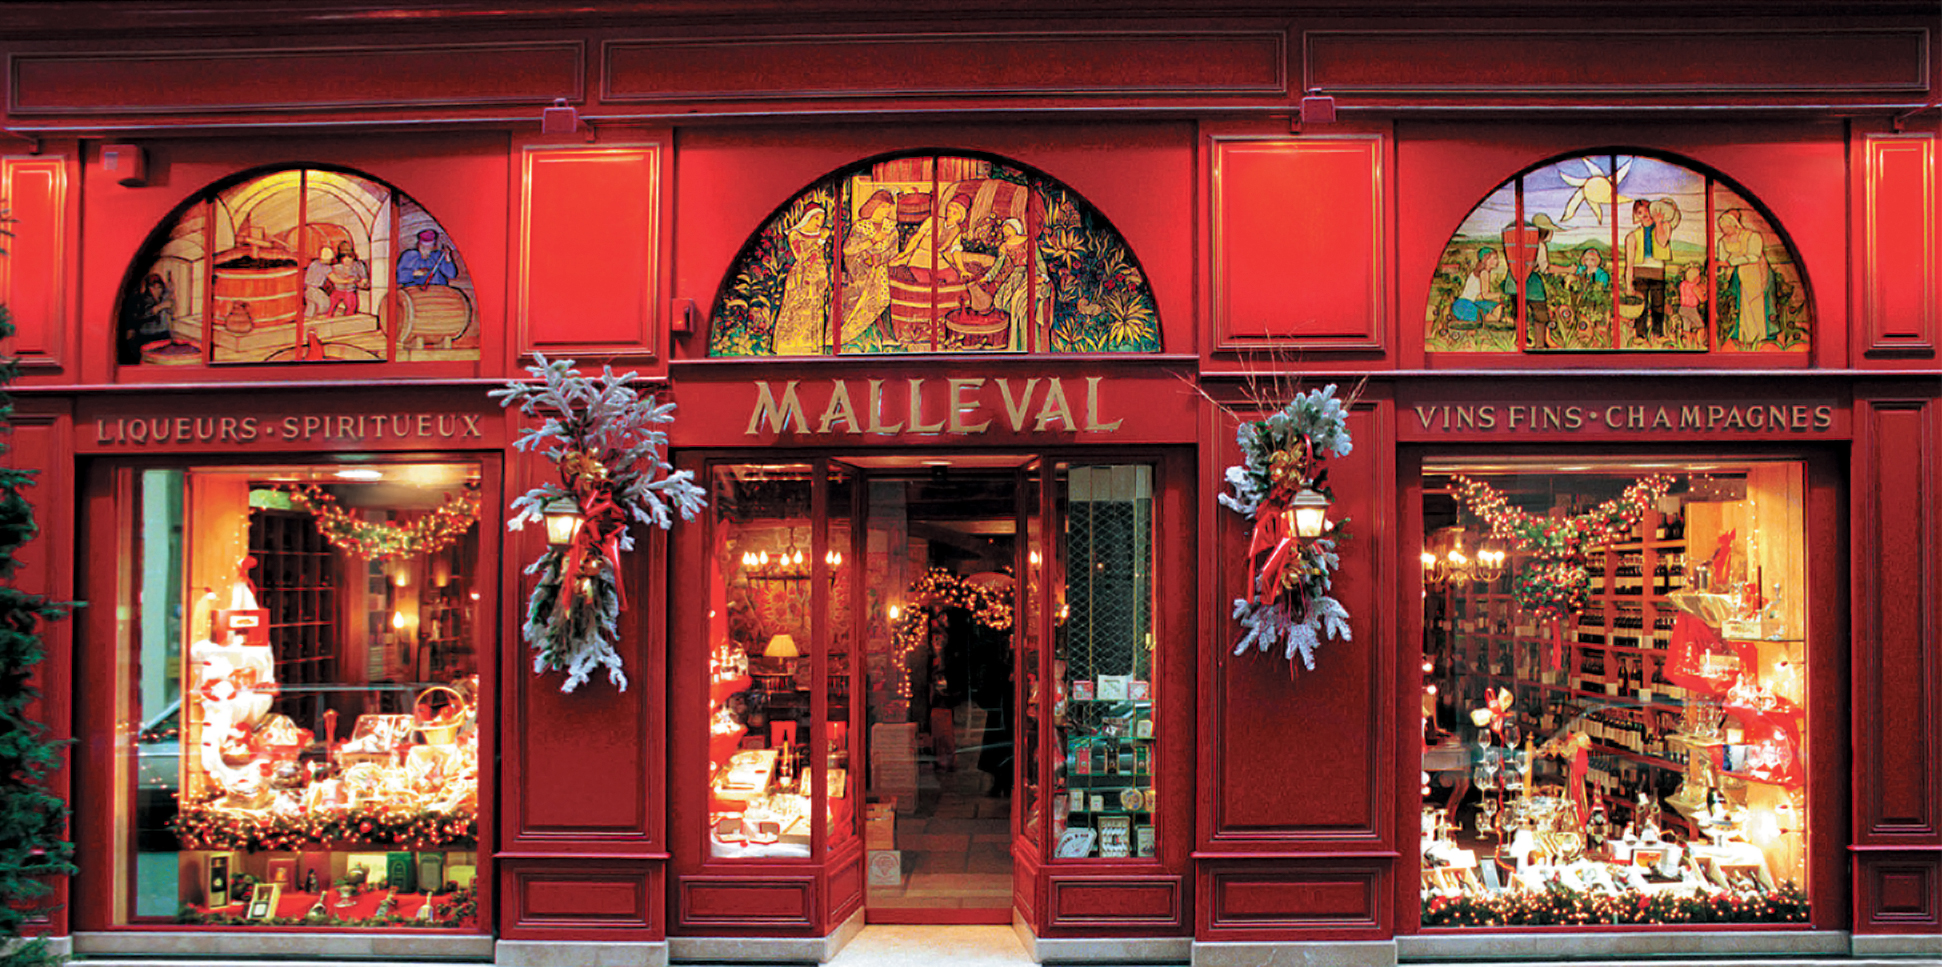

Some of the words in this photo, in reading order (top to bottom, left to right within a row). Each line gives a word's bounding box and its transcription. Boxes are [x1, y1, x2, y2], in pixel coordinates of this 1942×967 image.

[745, 376, 1123, 435] MALLEVAL
[1414, 405, 1495, 429] VINS
[1508, 405, 1583, 429] FINS
[1605, 405, 1833, 429] CHAMPAGNES
[97, 418, 258, 442] LIQUEURS
[282, 414, 482, 440] SPIRITUEUX
